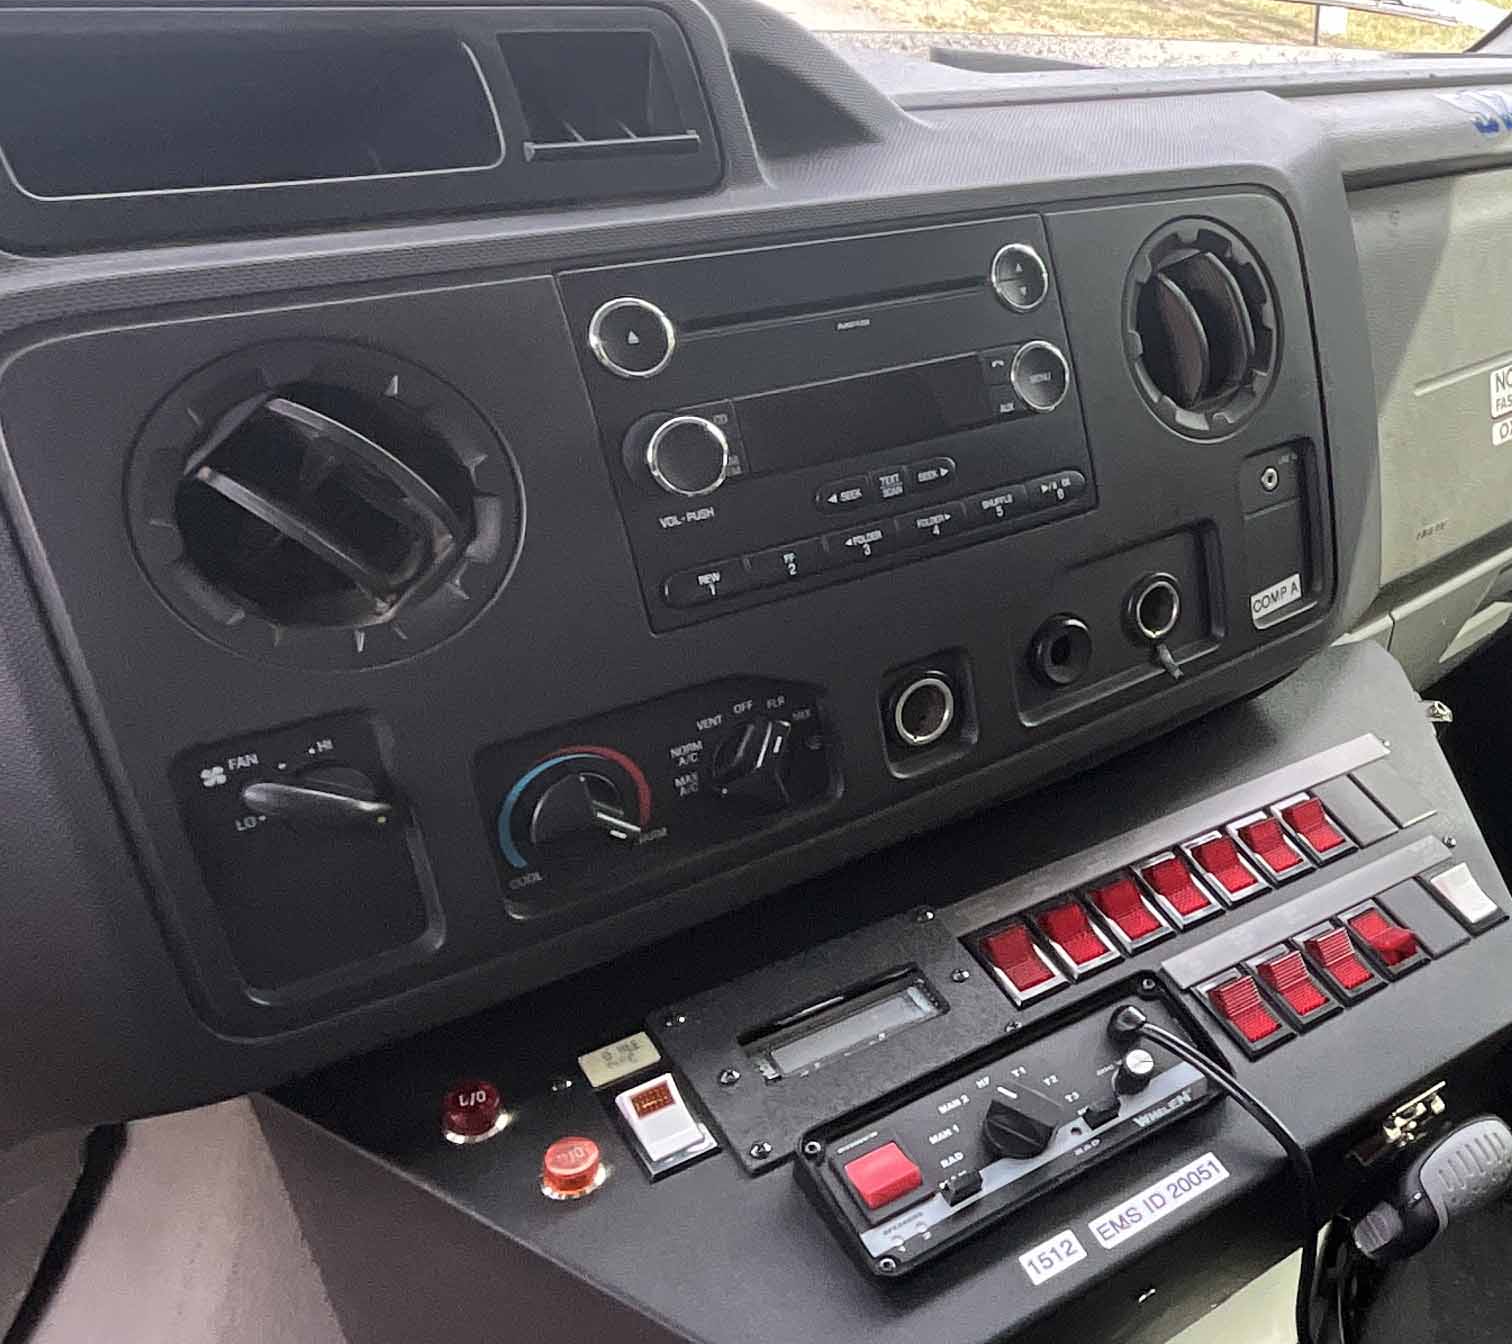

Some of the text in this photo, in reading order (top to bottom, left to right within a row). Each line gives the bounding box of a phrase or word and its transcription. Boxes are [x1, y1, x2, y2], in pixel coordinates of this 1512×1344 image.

[839, 488, 863, 503] SEEK
[995, 504, 1004, 518] 5
[931, 524, 940, 536] 4
[862, 543, 871, 557] 3
[787, 562, 798, 576] 2
[708, 583, 717, 596] 1
[1252, 579, 1299, 614] COMP A
[733, 699, 753, 715] OFF
[696, 714, 723, 732] VENT
[316, 739, 334, 753] HI
[670, 740, 704, 759] NORM
[228, 753, 259, 771] FAN
[235, 815, 257, 832] LO
[939, 1151, 965, 1169] RAD
[1095, 1159, 1222, 1242] EMS ID 20051
[1026, 1239, 1079, 1275] 1512
